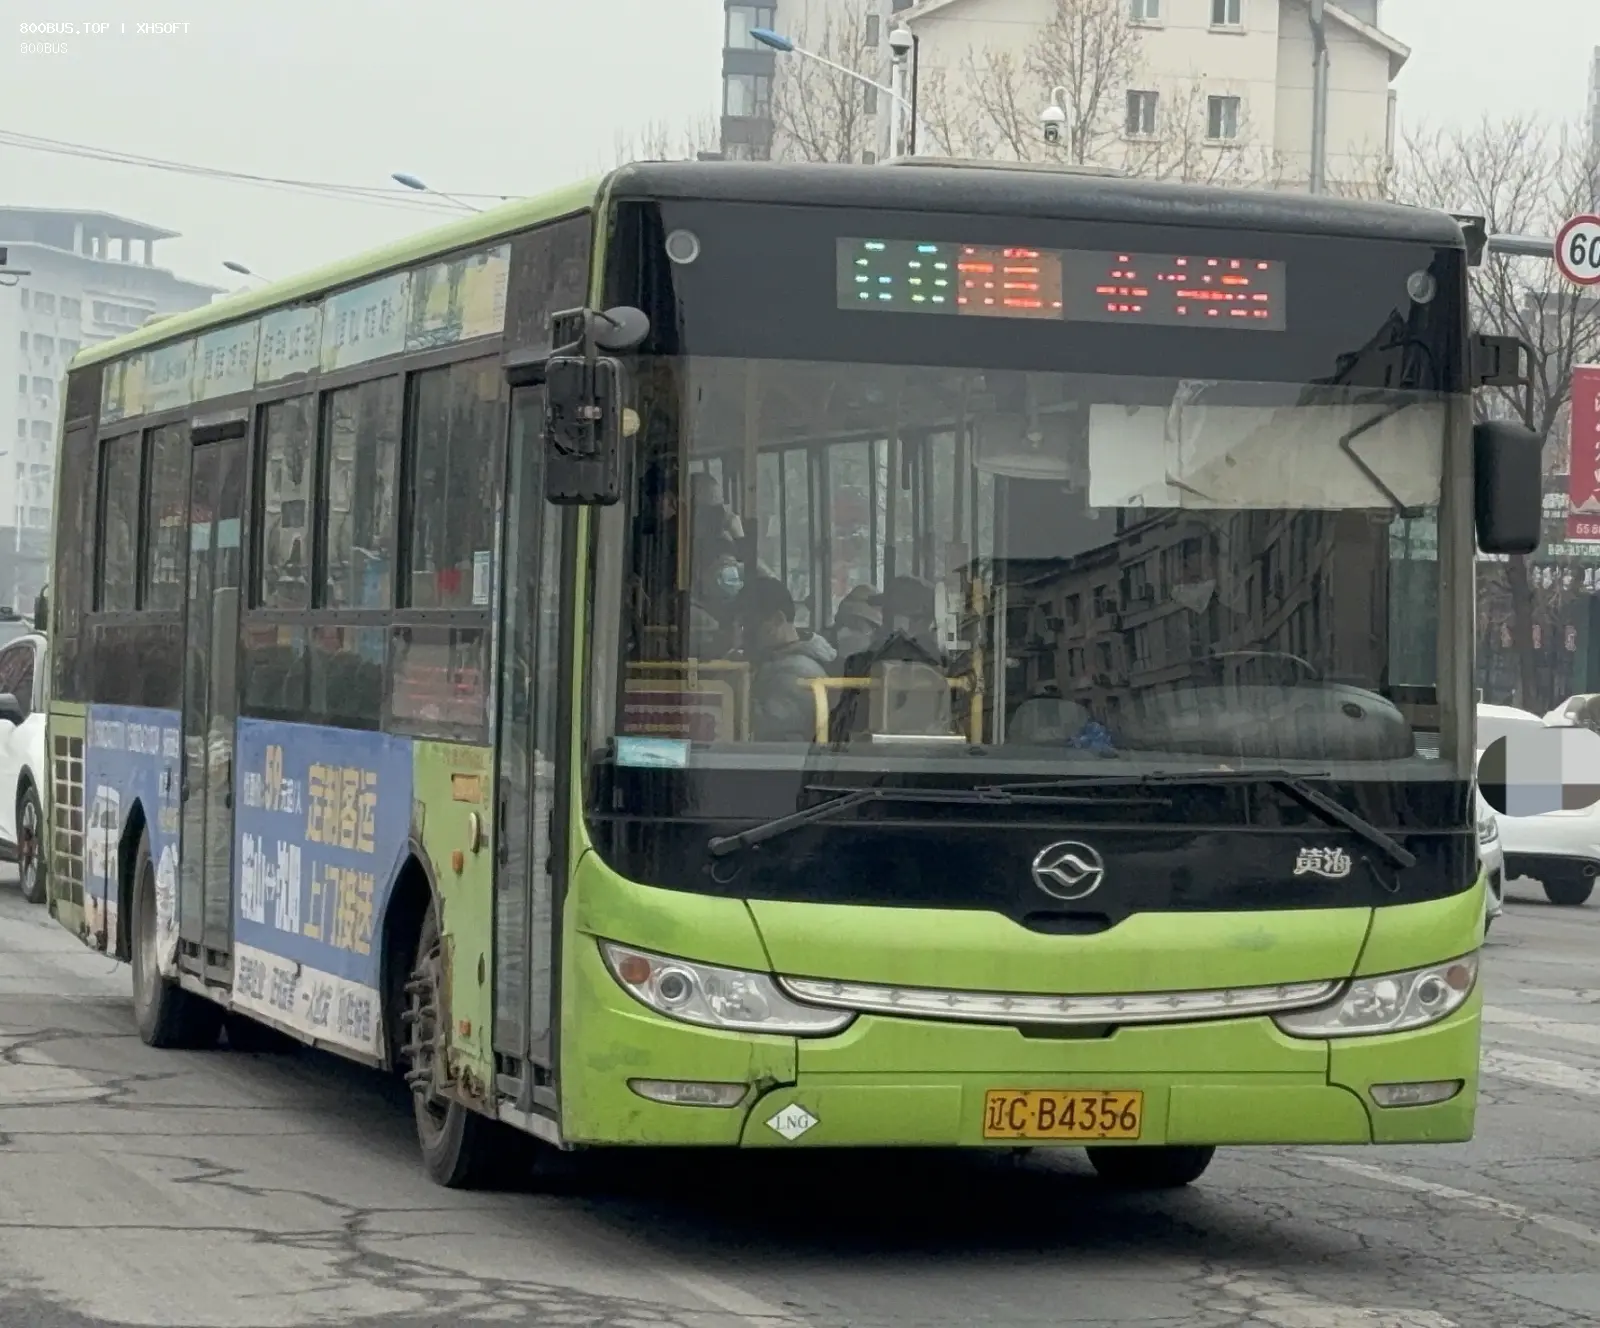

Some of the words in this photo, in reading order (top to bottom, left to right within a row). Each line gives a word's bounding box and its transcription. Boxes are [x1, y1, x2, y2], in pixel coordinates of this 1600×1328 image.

[1570, 233, 1600, 268] 60
[305, 761, 377, 854] 定制客运
[1293, 847, 1351, 878] 黄海
[303, 860, 375, 956] 上门接送
[776, 1114, 809, 1130] LNG
